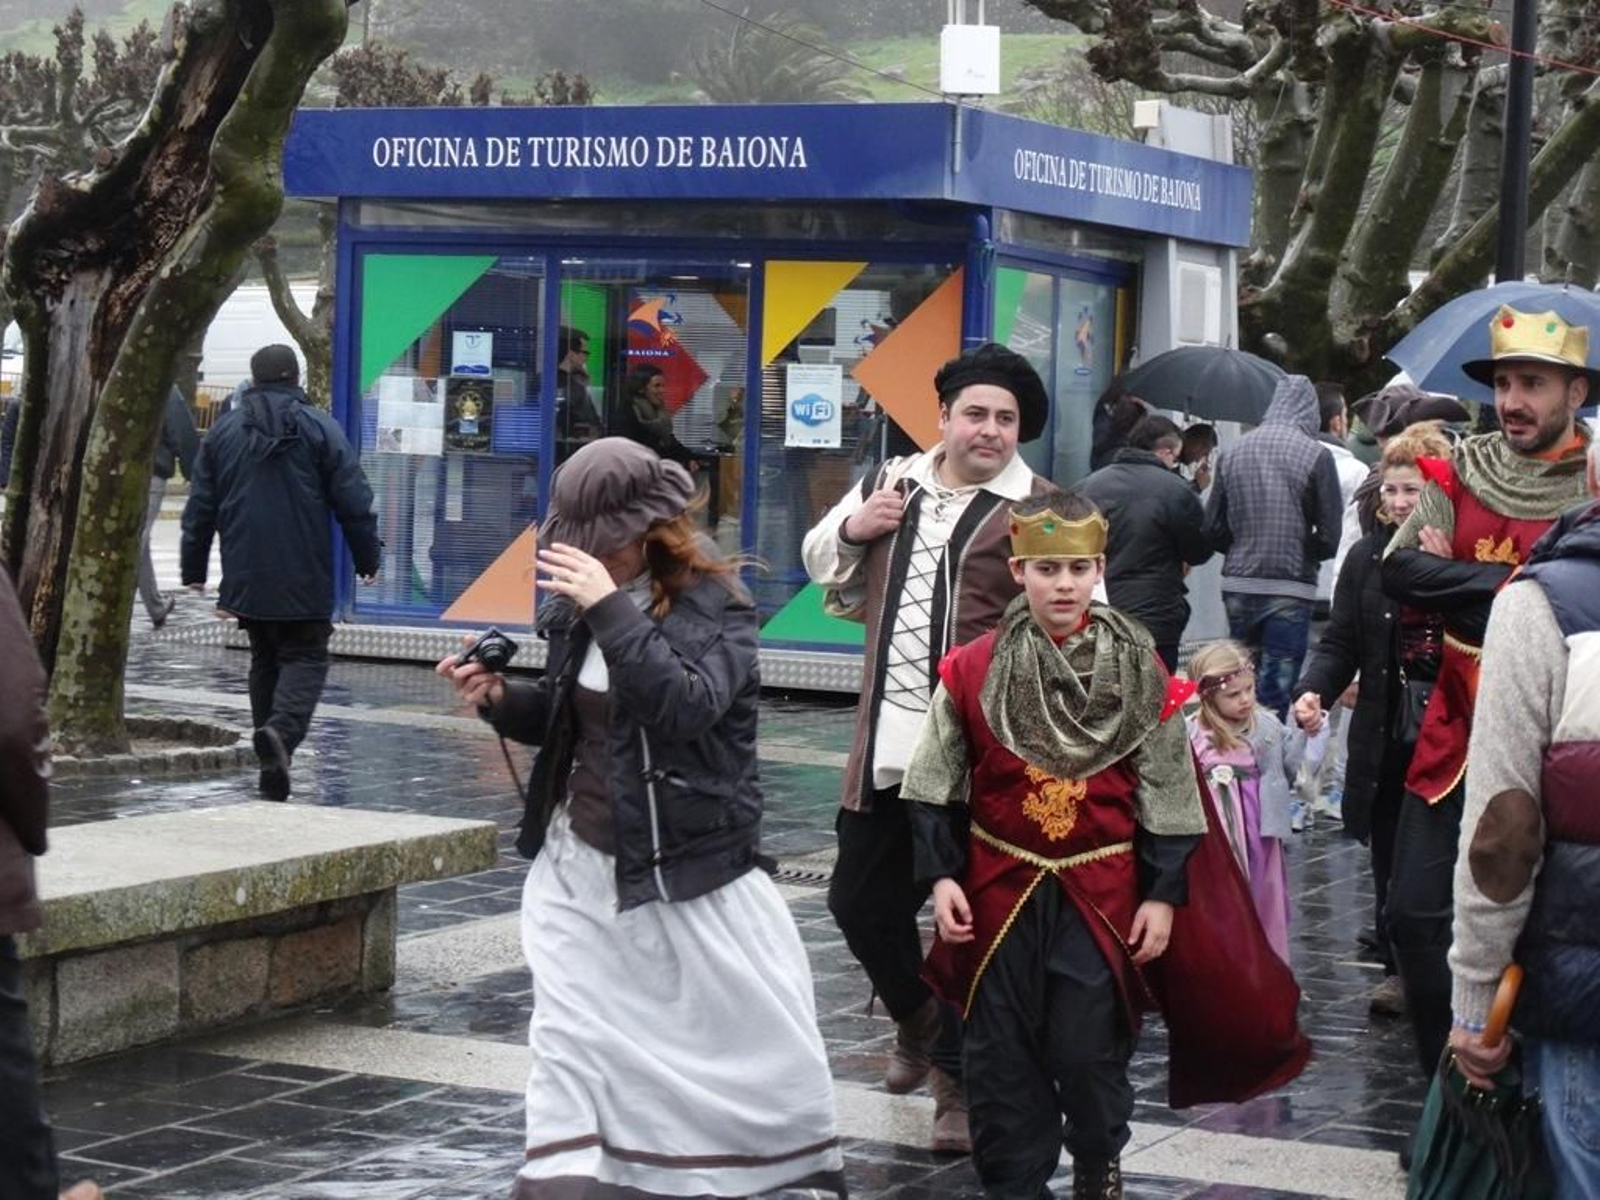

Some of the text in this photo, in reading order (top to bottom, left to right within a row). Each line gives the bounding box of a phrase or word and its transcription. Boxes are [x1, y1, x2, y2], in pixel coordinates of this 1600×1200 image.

[372, 136, 808, 168] OFICINA DE TURISMO DE BAIONA
[1014, 148, 1202, 212] OFICINA DE TURISMO DE BAIONA
[627, 349, 670, 357] BAIONA
